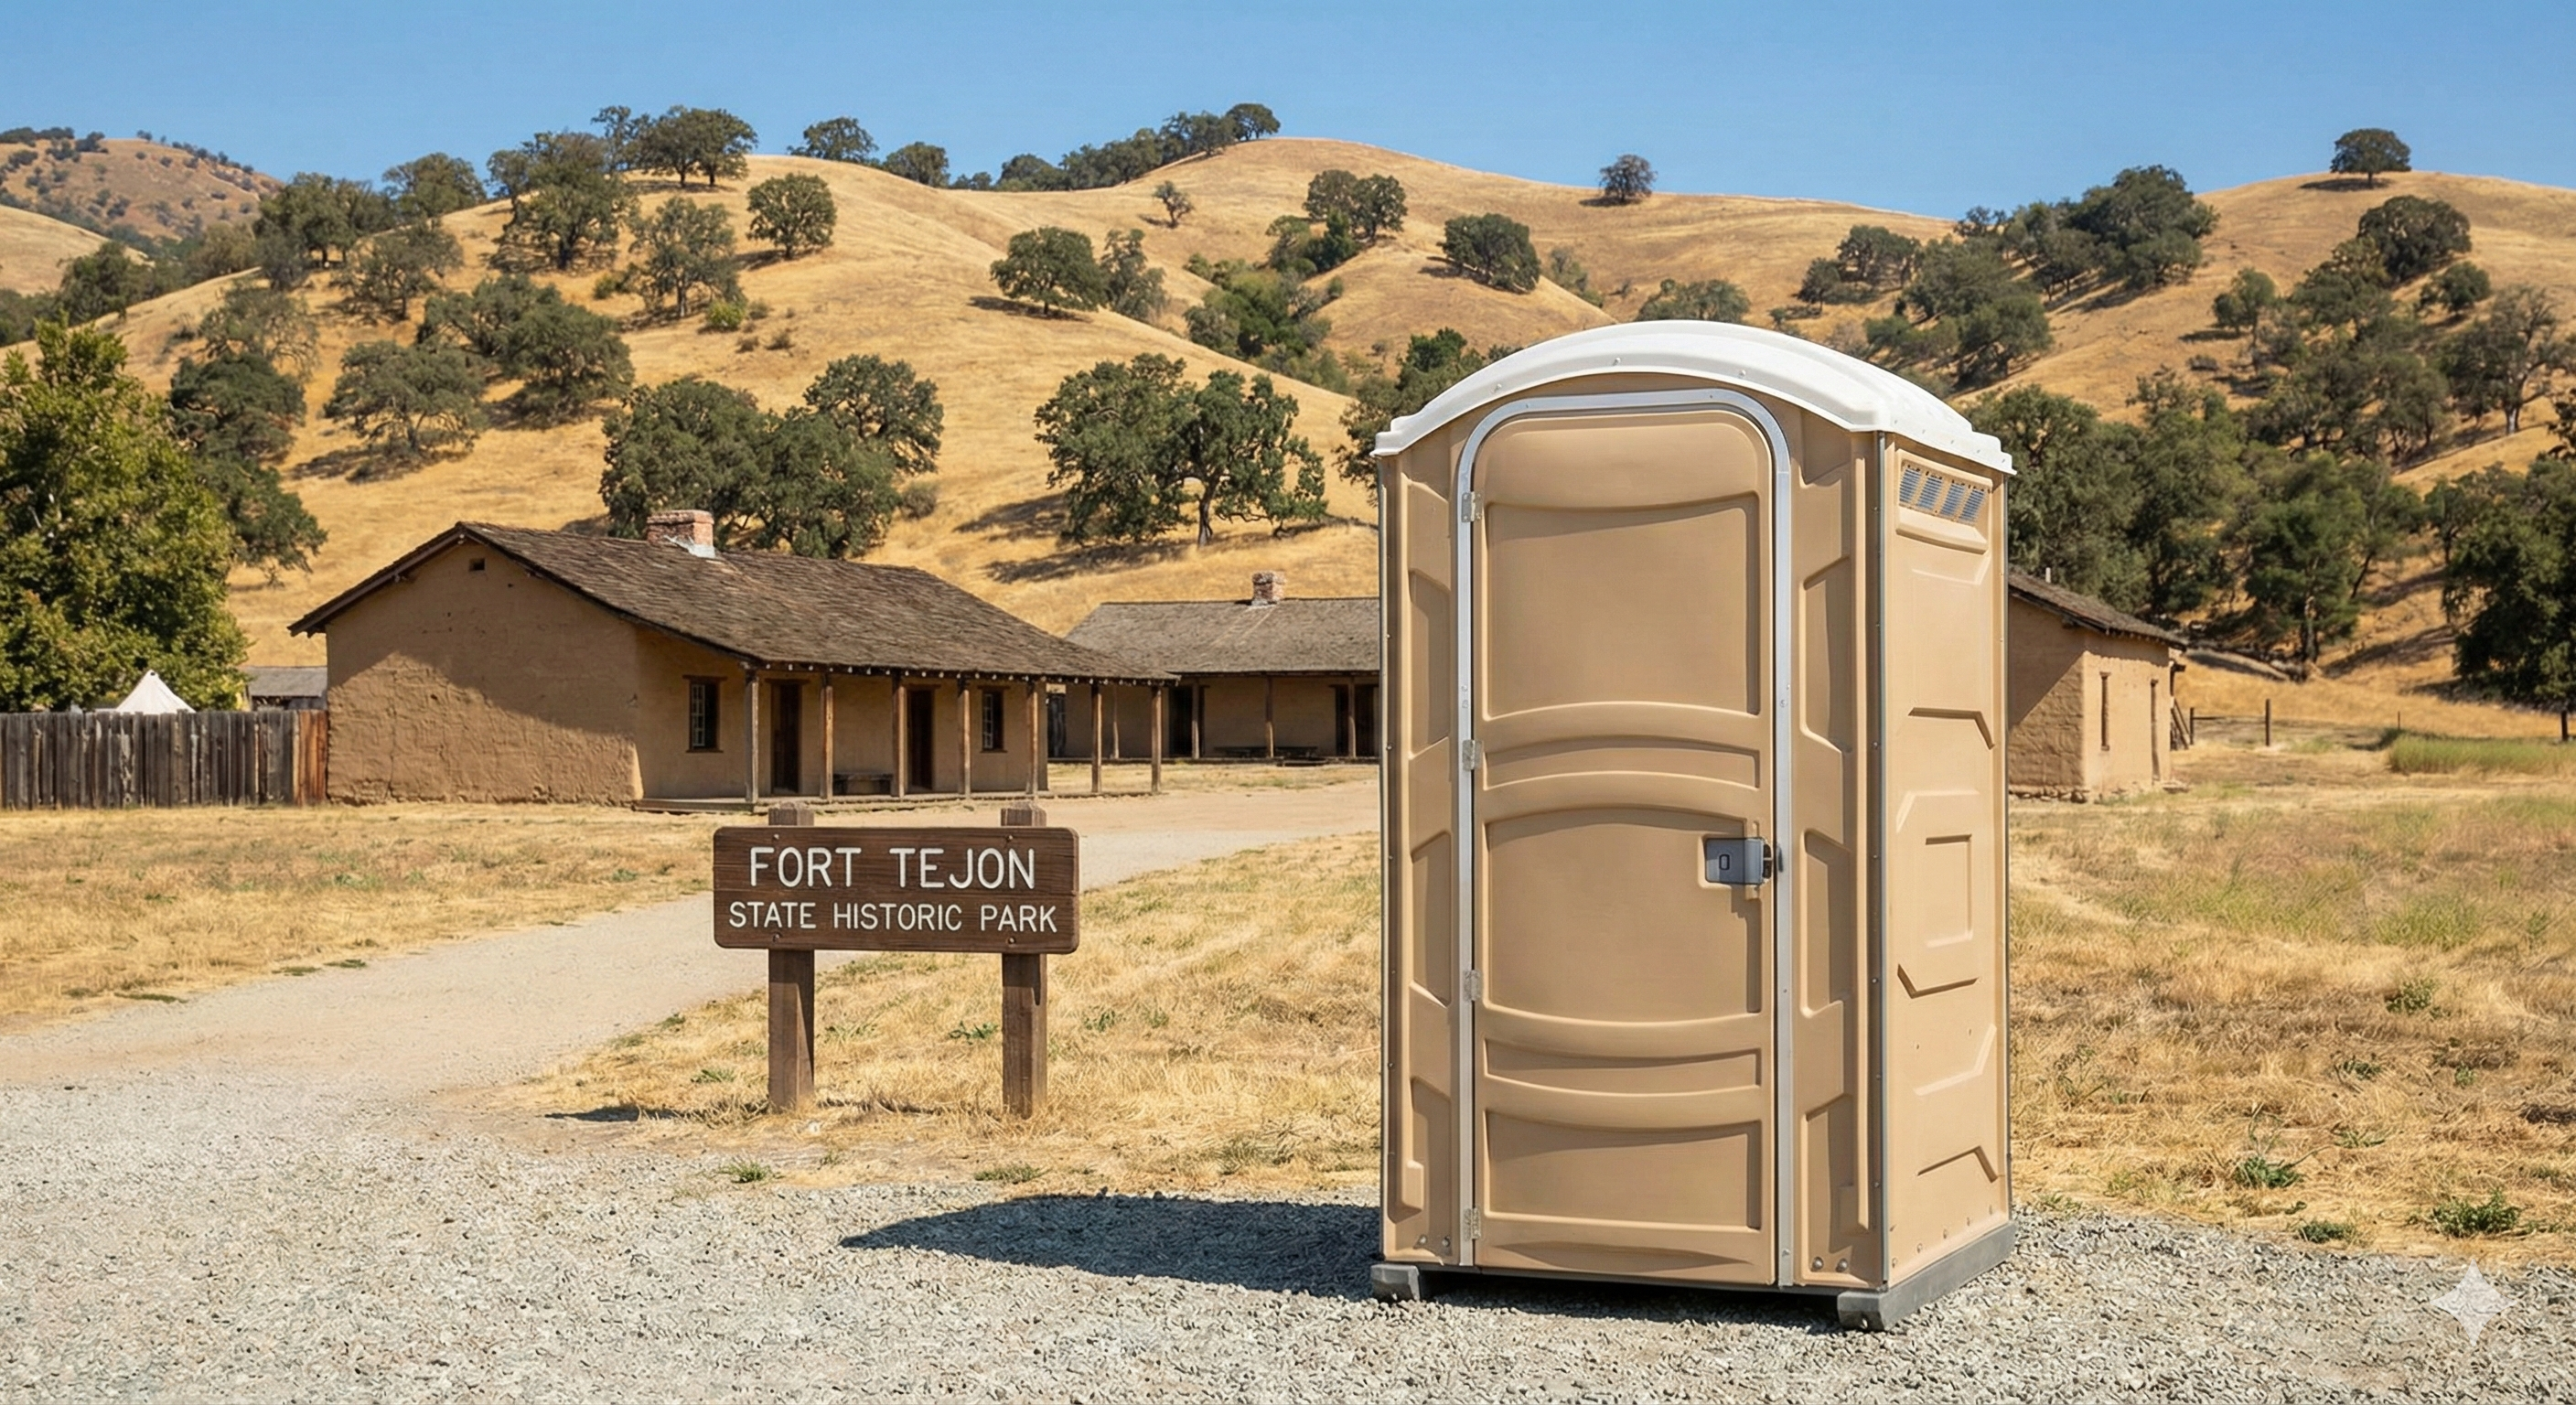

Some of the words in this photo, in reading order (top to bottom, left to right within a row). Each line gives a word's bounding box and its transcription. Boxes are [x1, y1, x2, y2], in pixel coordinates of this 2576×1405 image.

[750, 846, 862, 887] FORT
[888, 848, 1035, 889] TEJON
[728, 901, 817, 929] STATE
[833, 902, 962, 931] HISTORIC
[981, 904, 1057, 933] PARK
